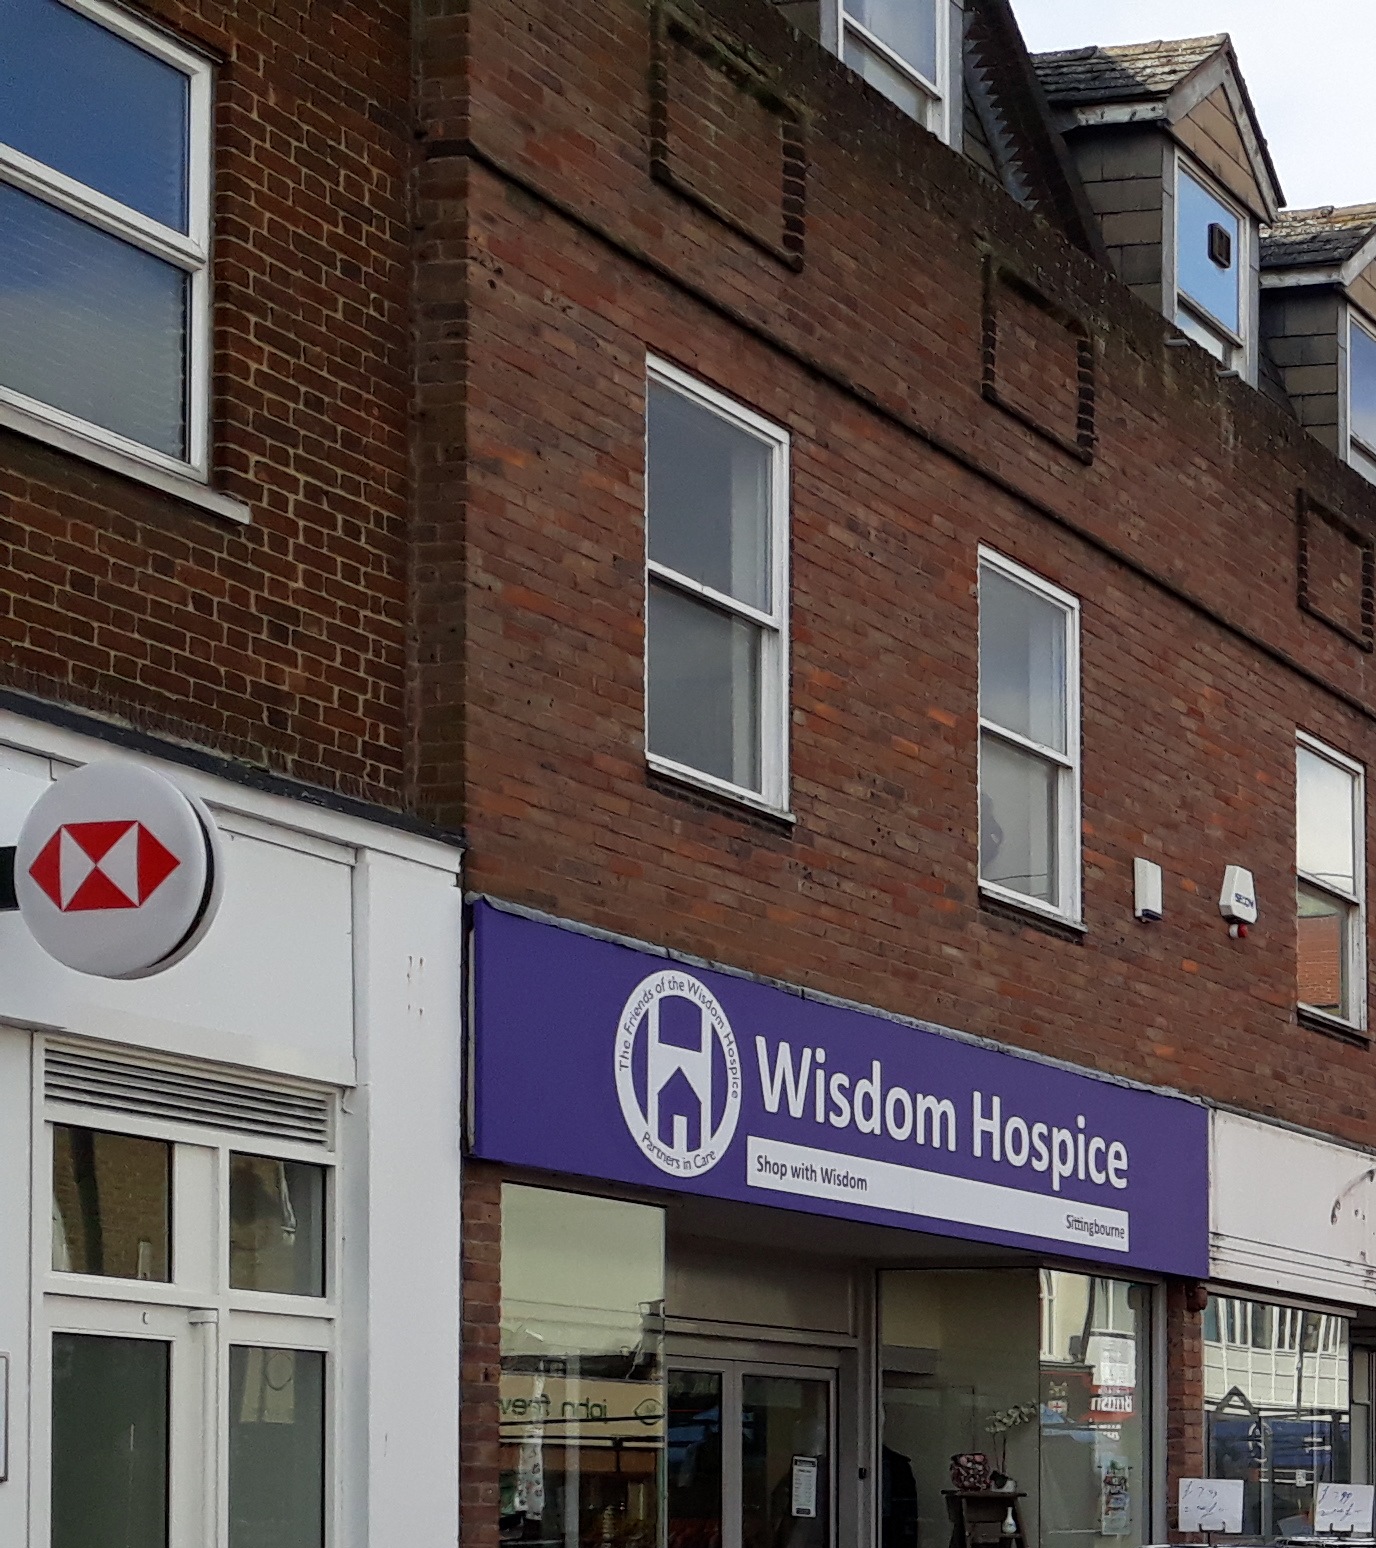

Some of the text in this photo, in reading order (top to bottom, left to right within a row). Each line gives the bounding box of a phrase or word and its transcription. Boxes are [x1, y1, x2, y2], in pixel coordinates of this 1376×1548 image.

[618, 975, 739, 1099] The Friends of the Wisdom Hospice
[754, 1035, 1129, 1192] Wisdom Hospice
[641, 1131, 716, 1170] Partners in Care
[756, 1154, 868, 1192] Shop with Wisdom
[1066, 1214, 1125, 1240] Sittingbourne
